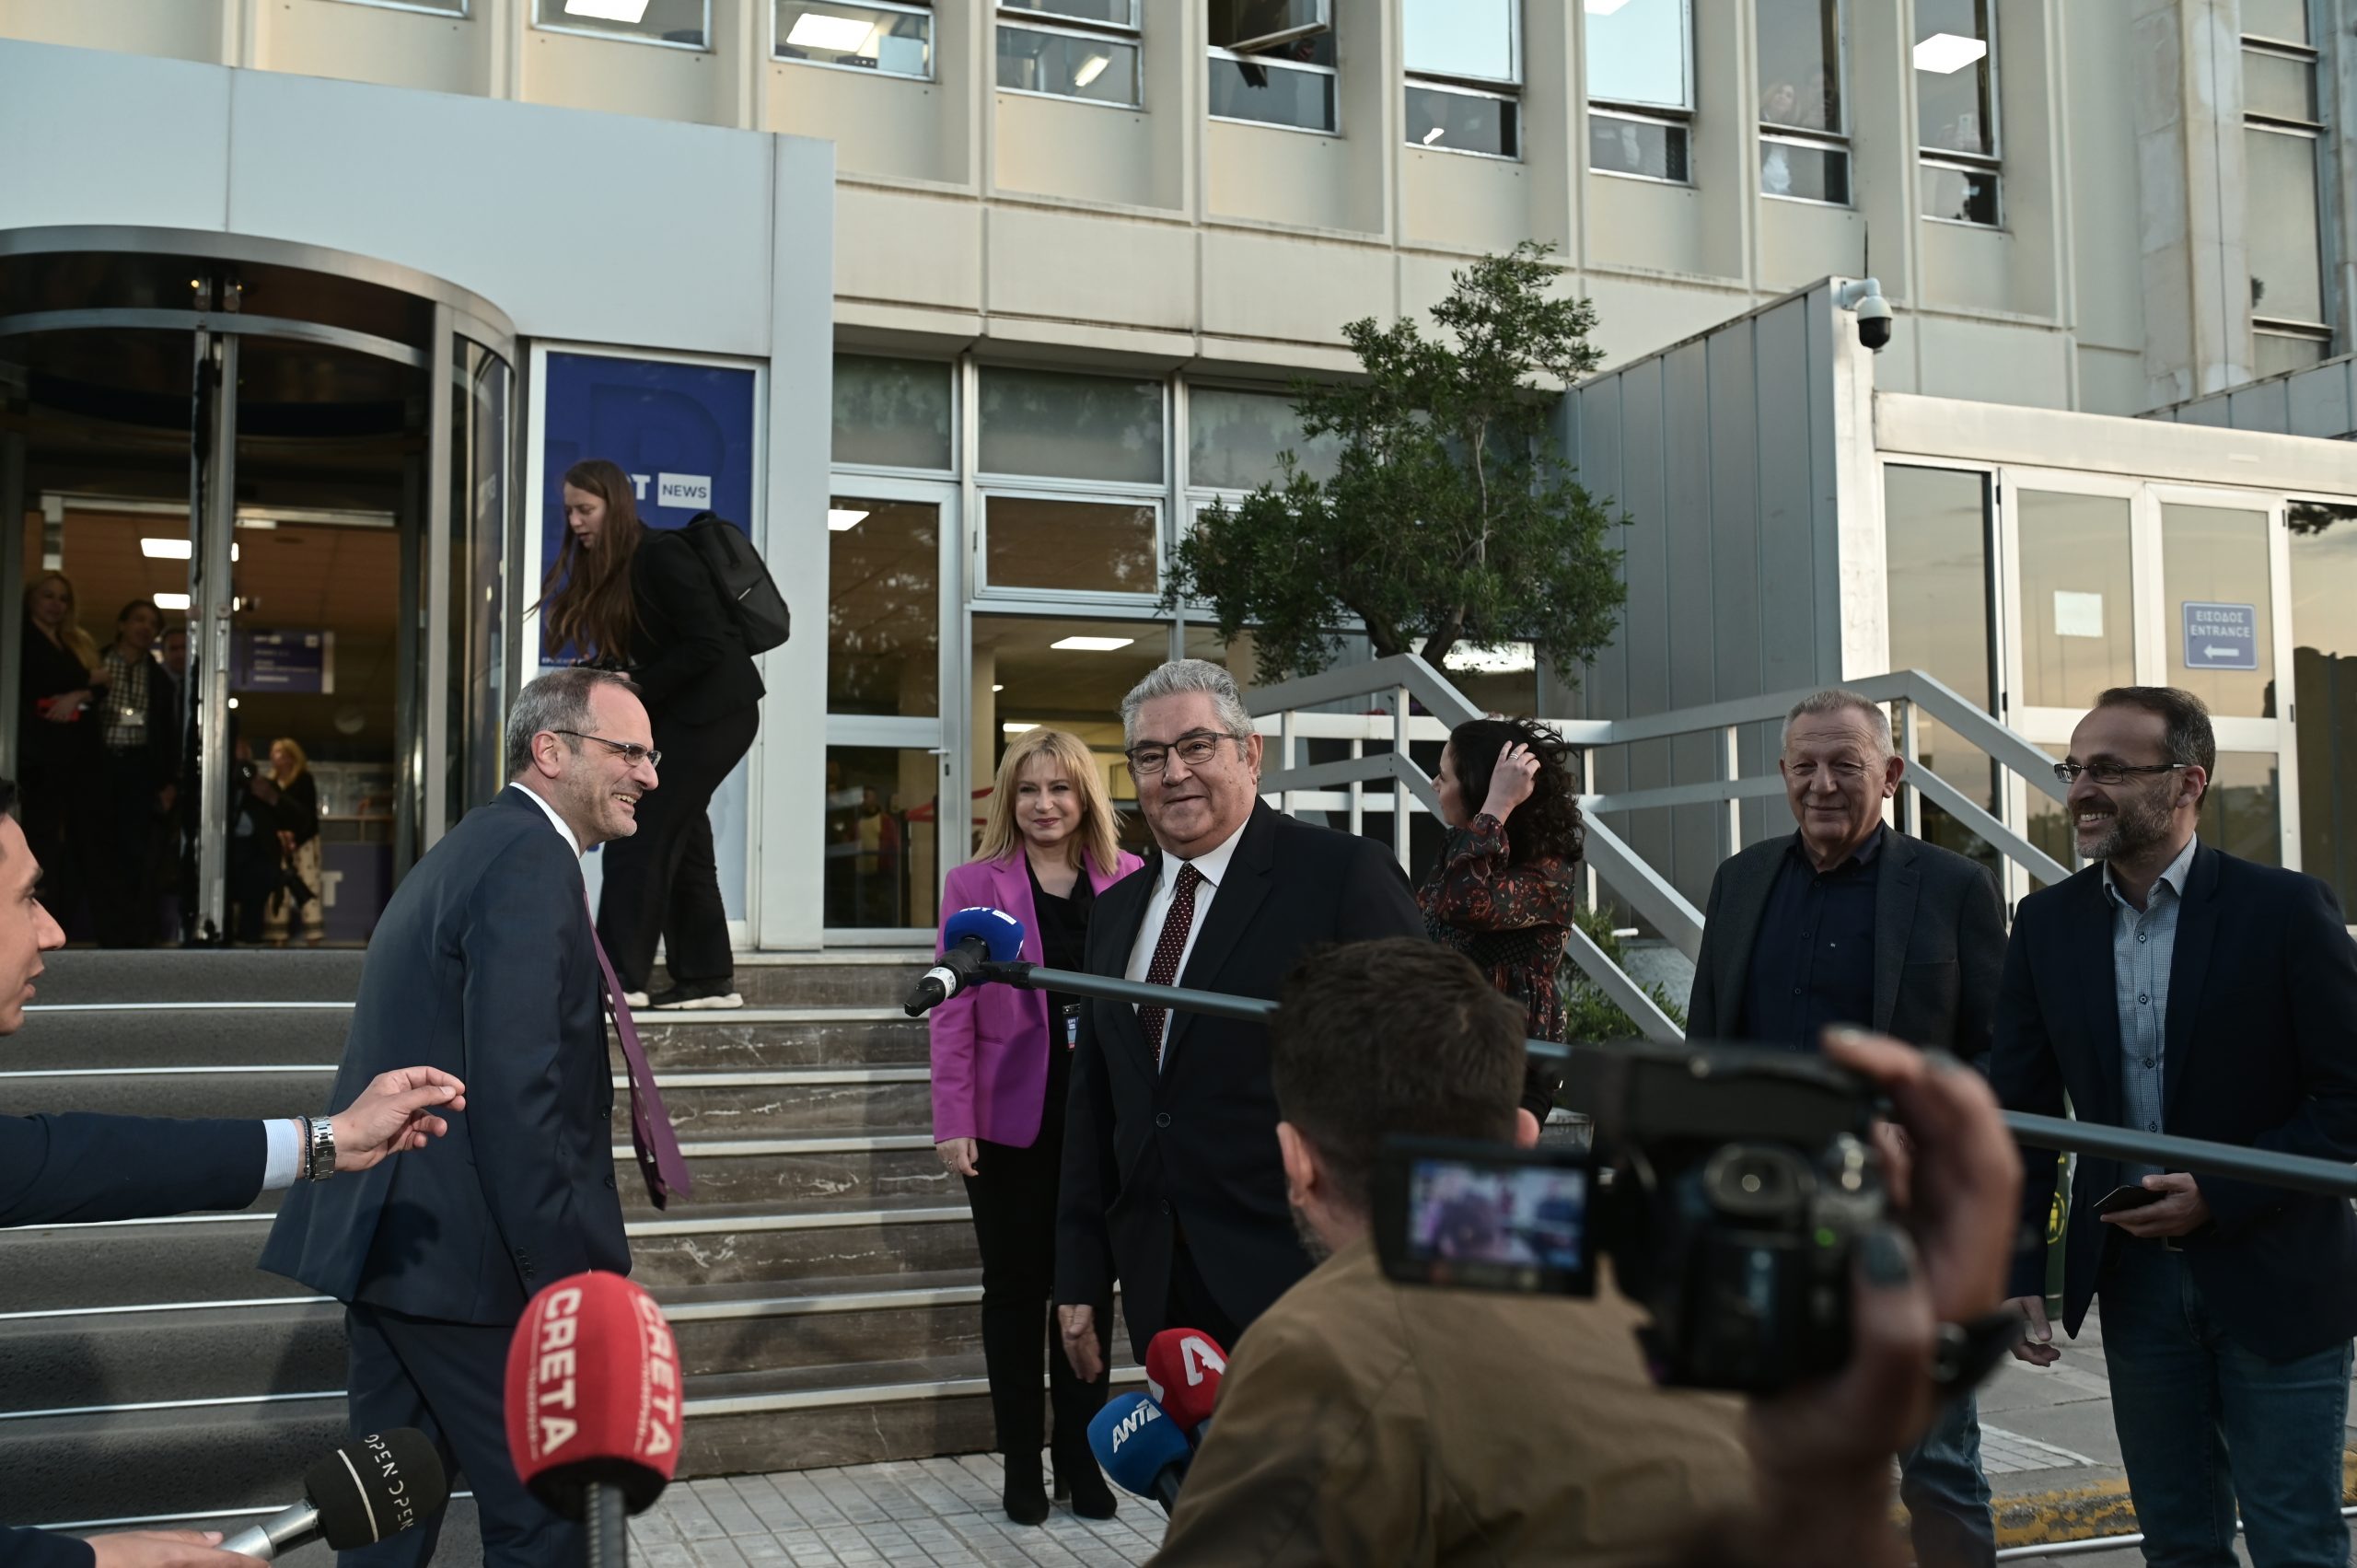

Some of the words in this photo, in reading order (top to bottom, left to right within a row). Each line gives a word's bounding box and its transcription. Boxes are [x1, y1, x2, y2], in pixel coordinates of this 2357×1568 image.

[662, 484, 707, 498] NEWS
[2189, 624, 2252, 638] ENTRANCE
[2195, 610, 2245, 623] ΕΙΣΟΔΟΣ
[539, 1286, 583, 1457] CRETA
[637, 1293, 677, 1457] CRETA
[364, 1434, 399, 1478] OPEN
[389, 1481, 414, 1531] OPEN
